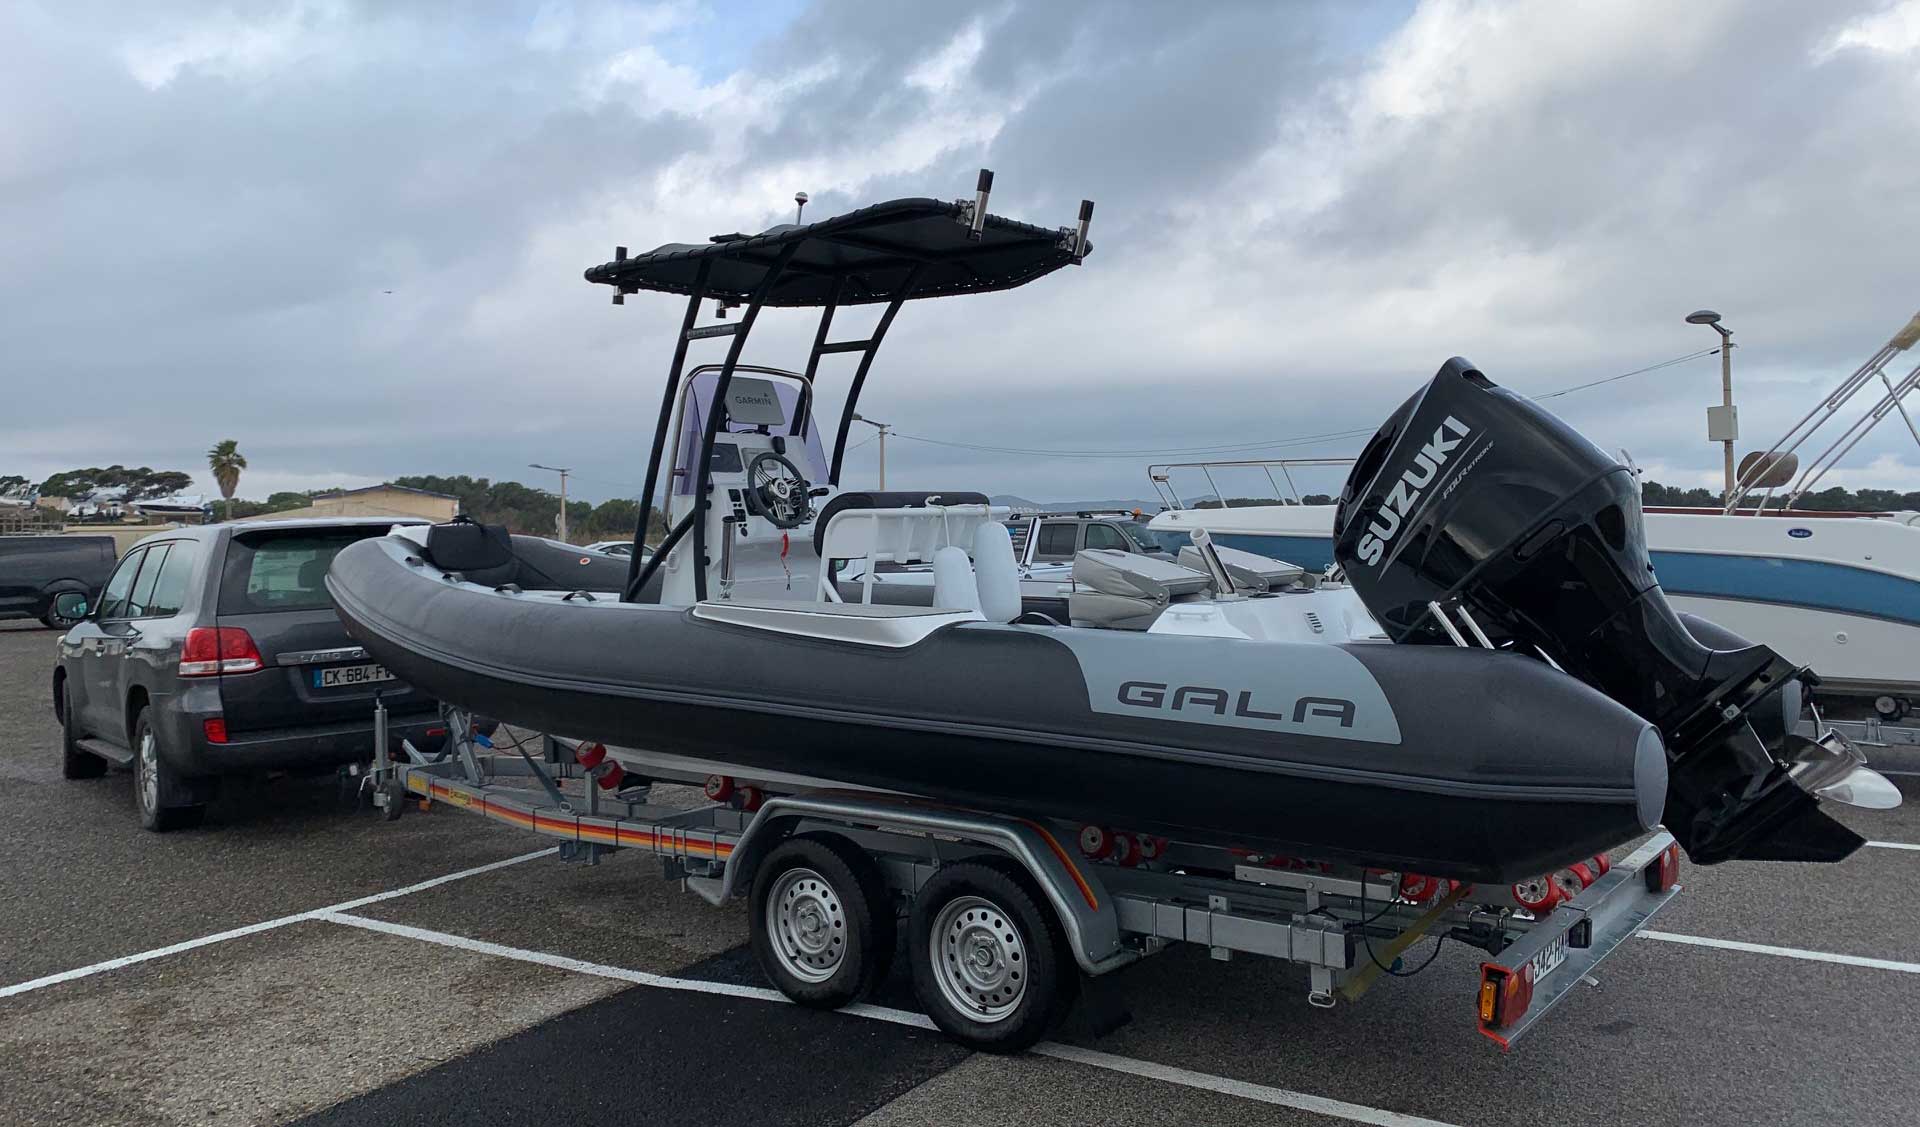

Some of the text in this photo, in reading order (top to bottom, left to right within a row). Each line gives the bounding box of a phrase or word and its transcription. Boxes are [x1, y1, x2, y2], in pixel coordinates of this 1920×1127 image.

[735, 395, 772, 407] GARMIN
[1357, 415, 1471, 567] SUZUKI
[1117, 680, 1357, 728] GALA
